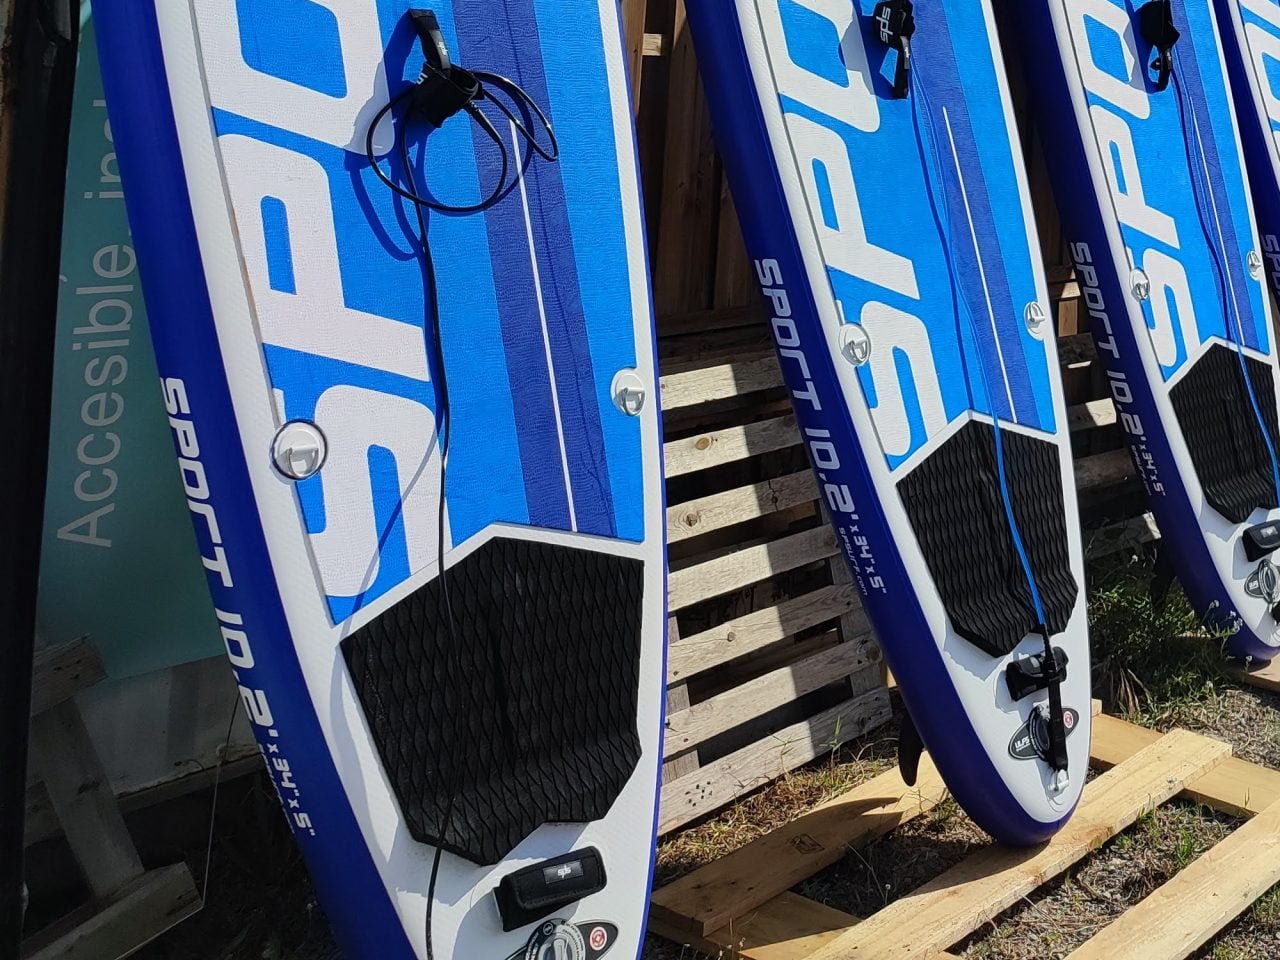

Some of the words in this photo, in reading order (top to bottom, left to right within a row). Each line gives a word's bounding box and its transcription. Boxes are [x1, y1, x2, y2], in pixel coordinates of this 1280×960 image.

[57, 227, 137, 548] Accesible
[754, 258, 823, 411] SPORT
[1070, 241, 1121, 360] SPORT
[159, 376, 234, 588] SPORT
